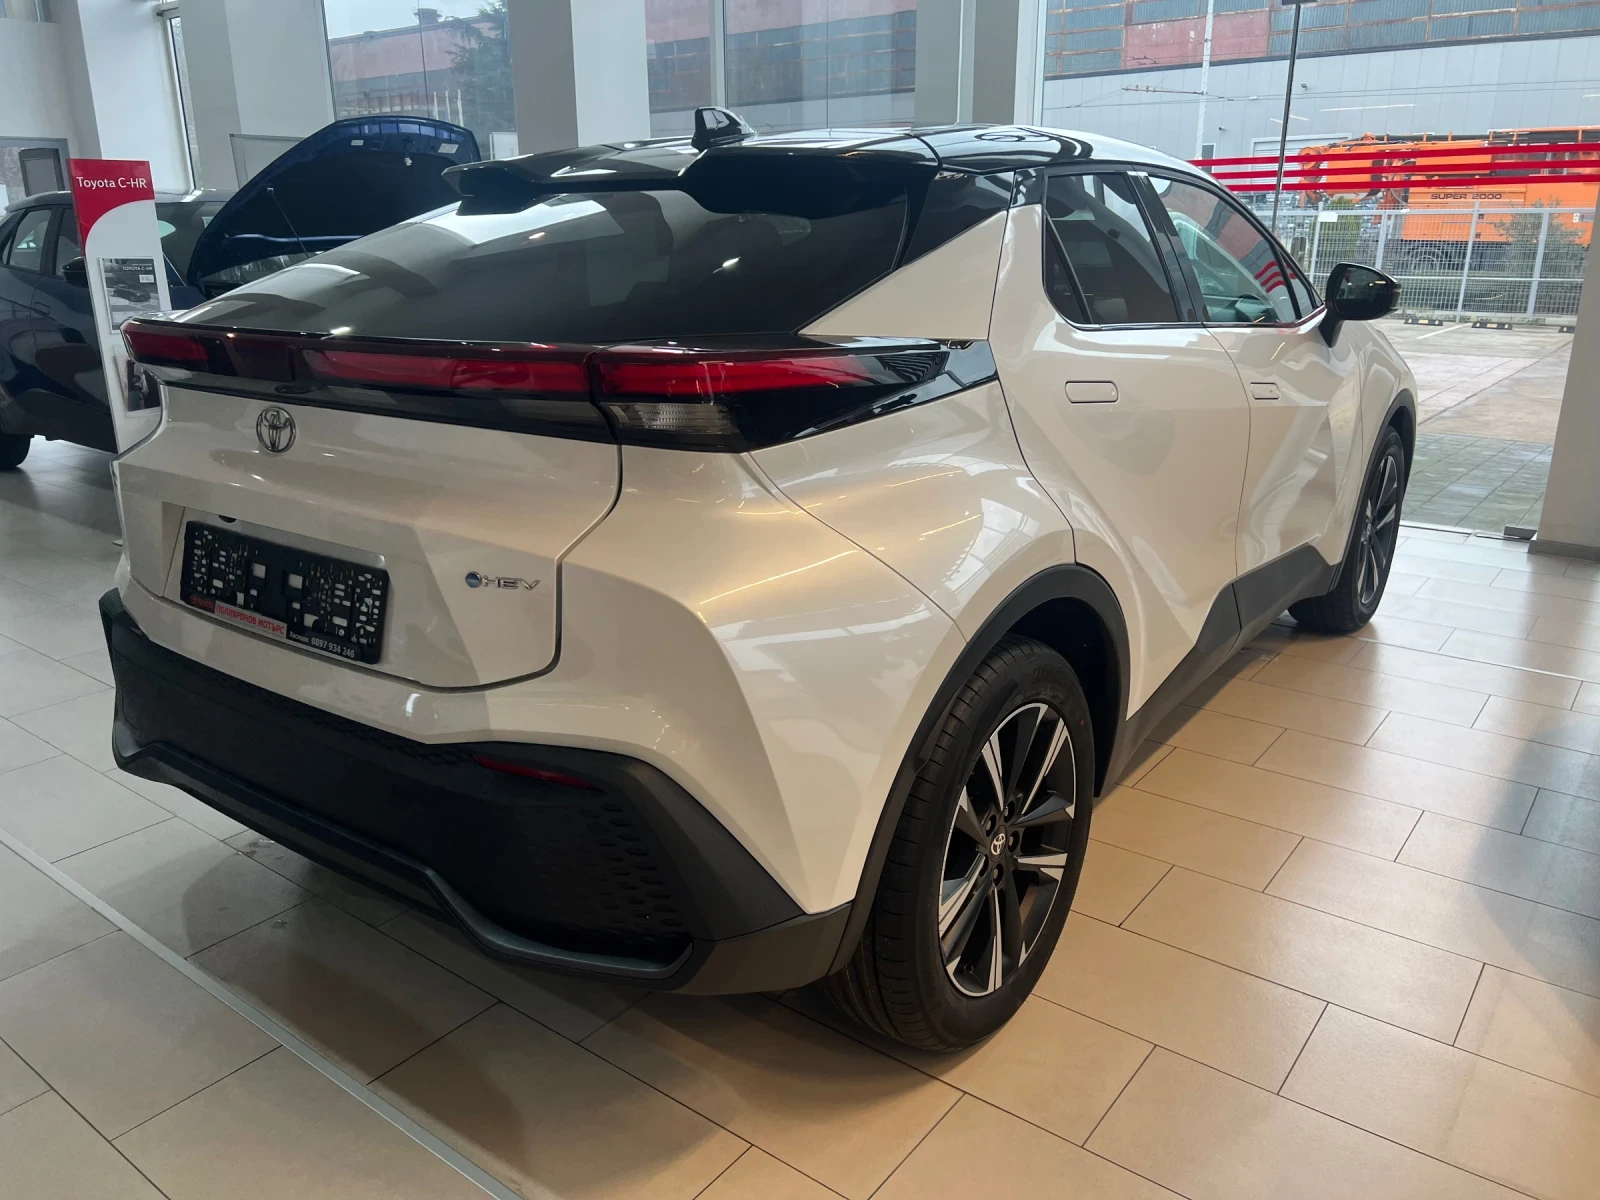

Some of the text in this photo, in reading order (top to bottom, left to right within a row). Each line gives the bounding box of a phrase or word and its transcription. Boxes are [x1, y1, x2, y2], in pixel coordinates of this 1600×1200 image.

[76, 176, 147, 190] Toyota C-HR
[482, 575, 541, 591] HEV
[216, 604, 285, 635] ПОЛИХРОНОВ МОТЪРС
[311, 637, 328, 649] 0897
[328, 642, 341, 654] 934
[342, 647, 355, 658] 246
